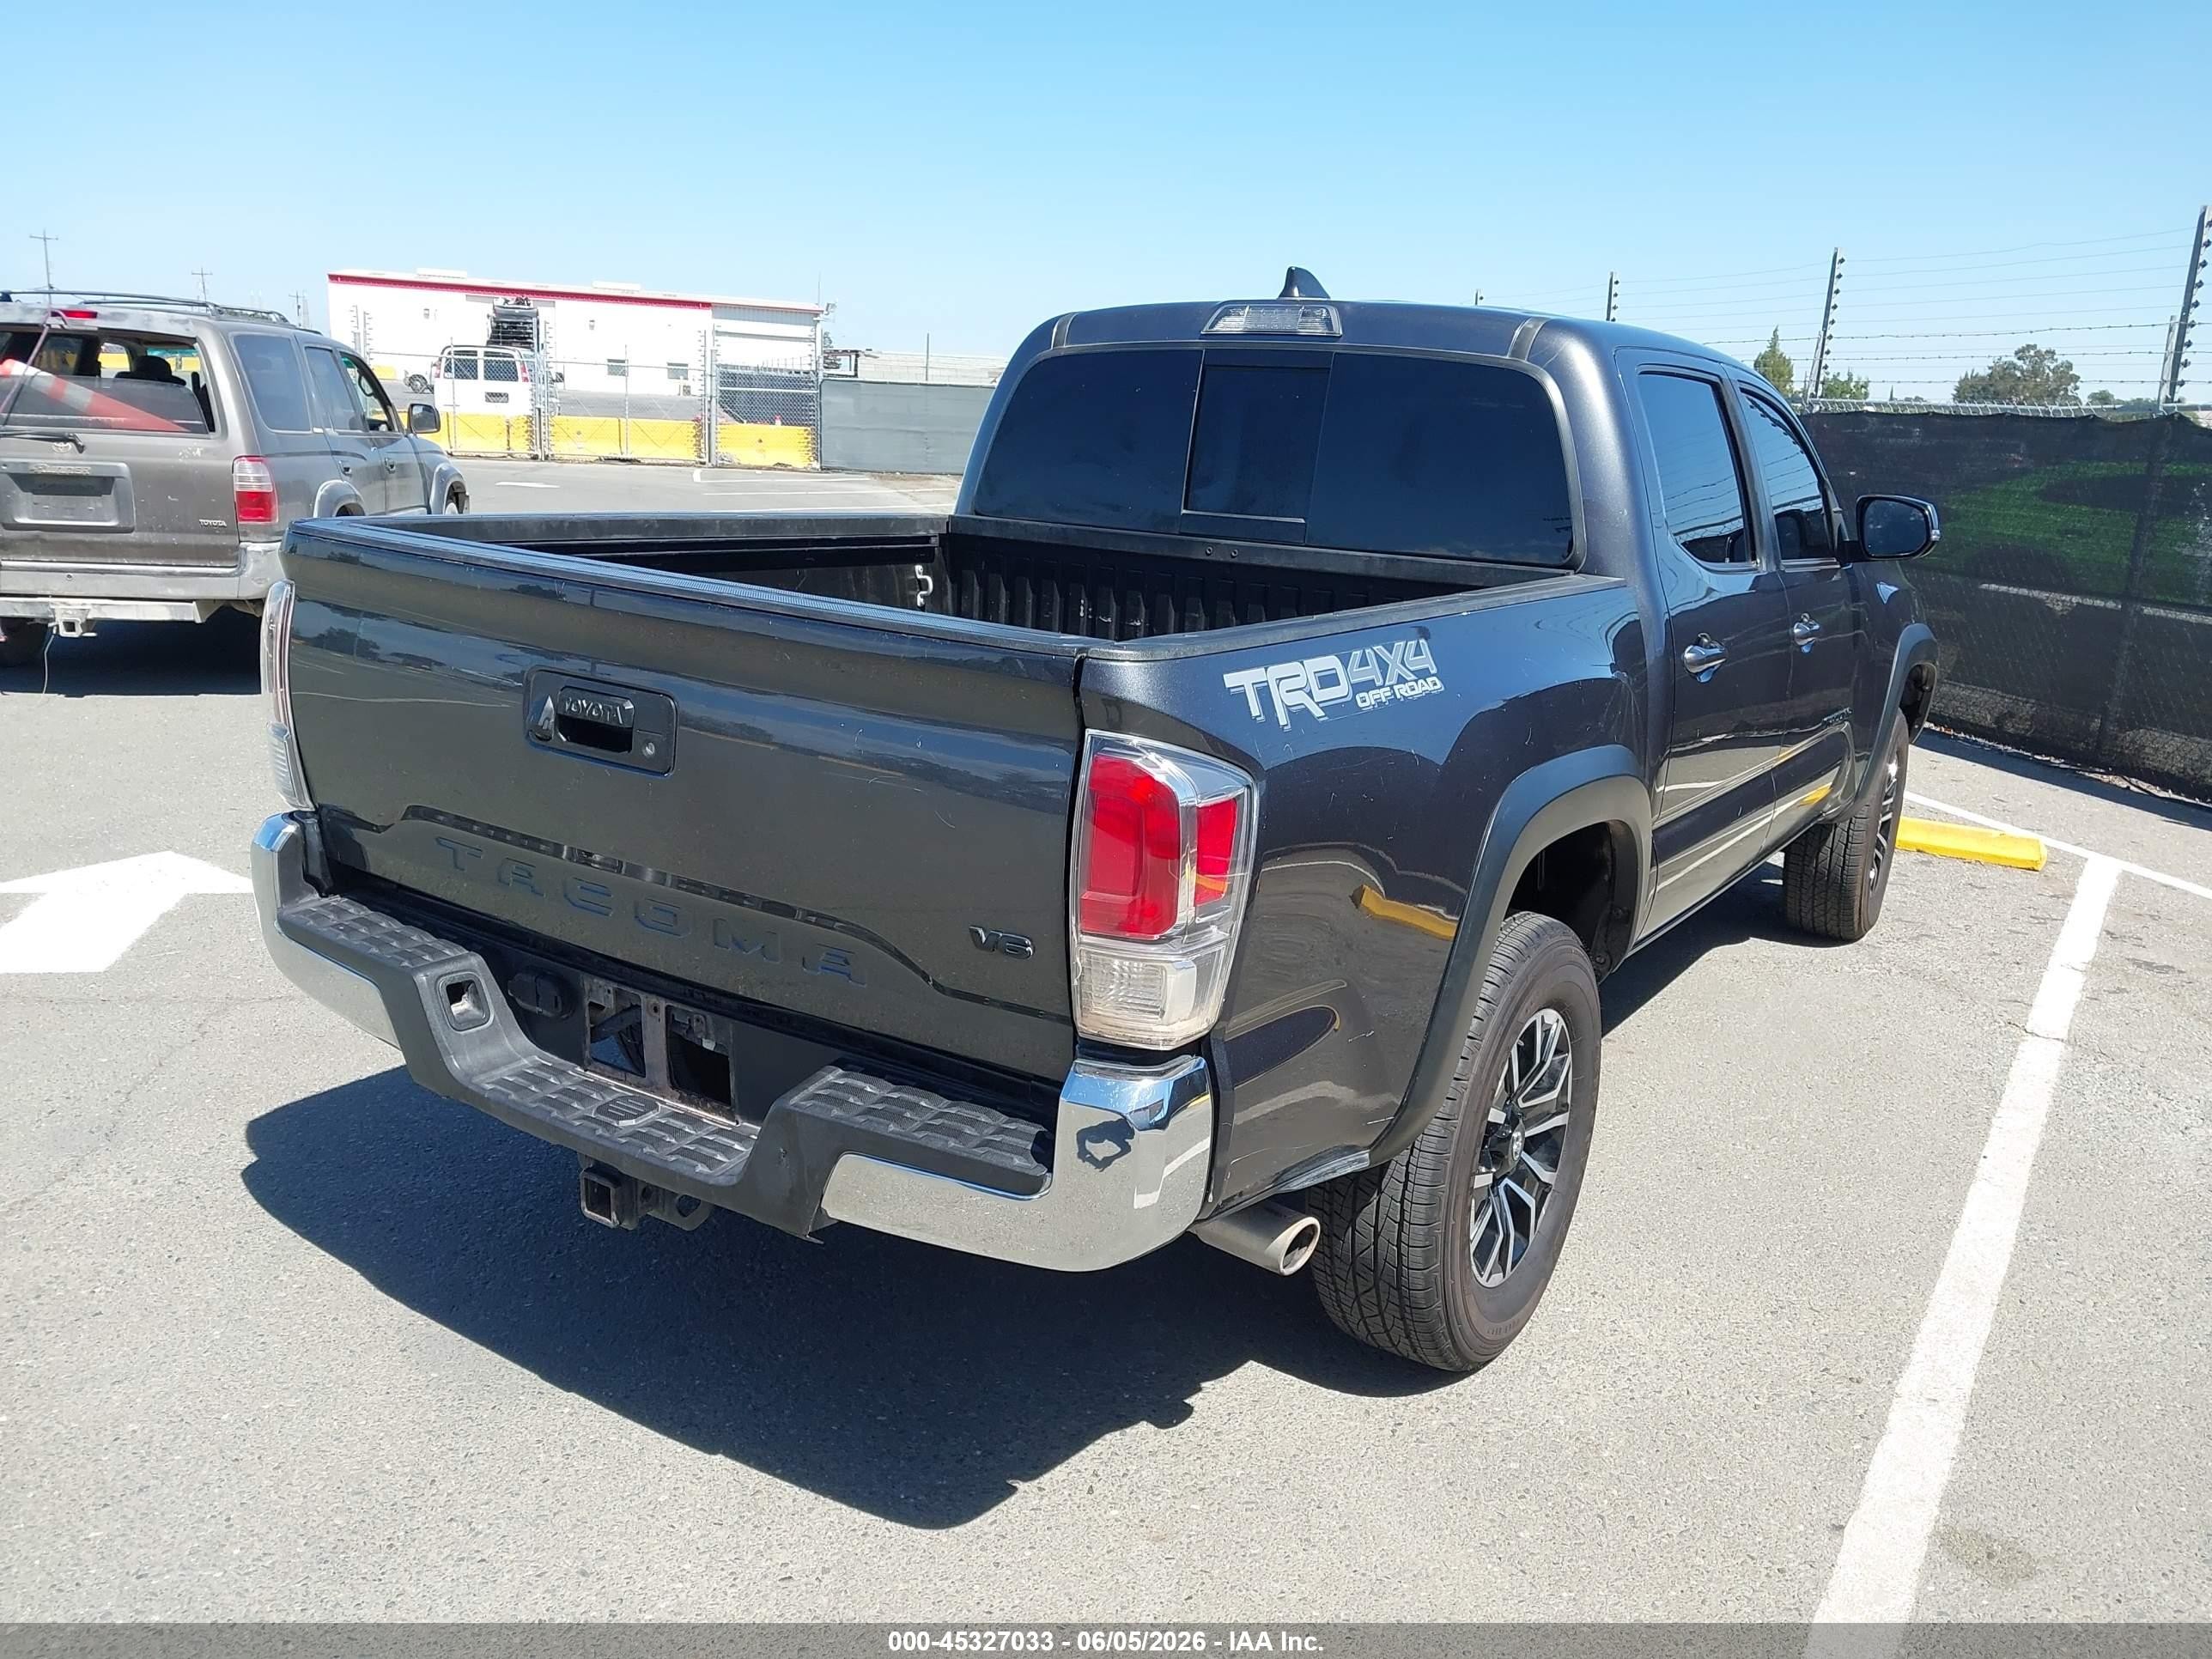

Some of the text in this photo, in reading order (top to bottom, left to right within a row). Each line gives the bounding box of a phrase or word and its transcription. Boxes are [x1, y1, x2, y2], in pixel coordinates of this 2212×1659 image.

[198, 519, 228, 527] TOYOTA
[1223, 638, 1438, 732] TRD 4X4
[1355, 675, 1446, 711] OFF ROAD
[563, 696, 623, 725] TOYOTA
[434, 836, 868, 988] TACOMA
[968, 924, 1036, 960] V6
